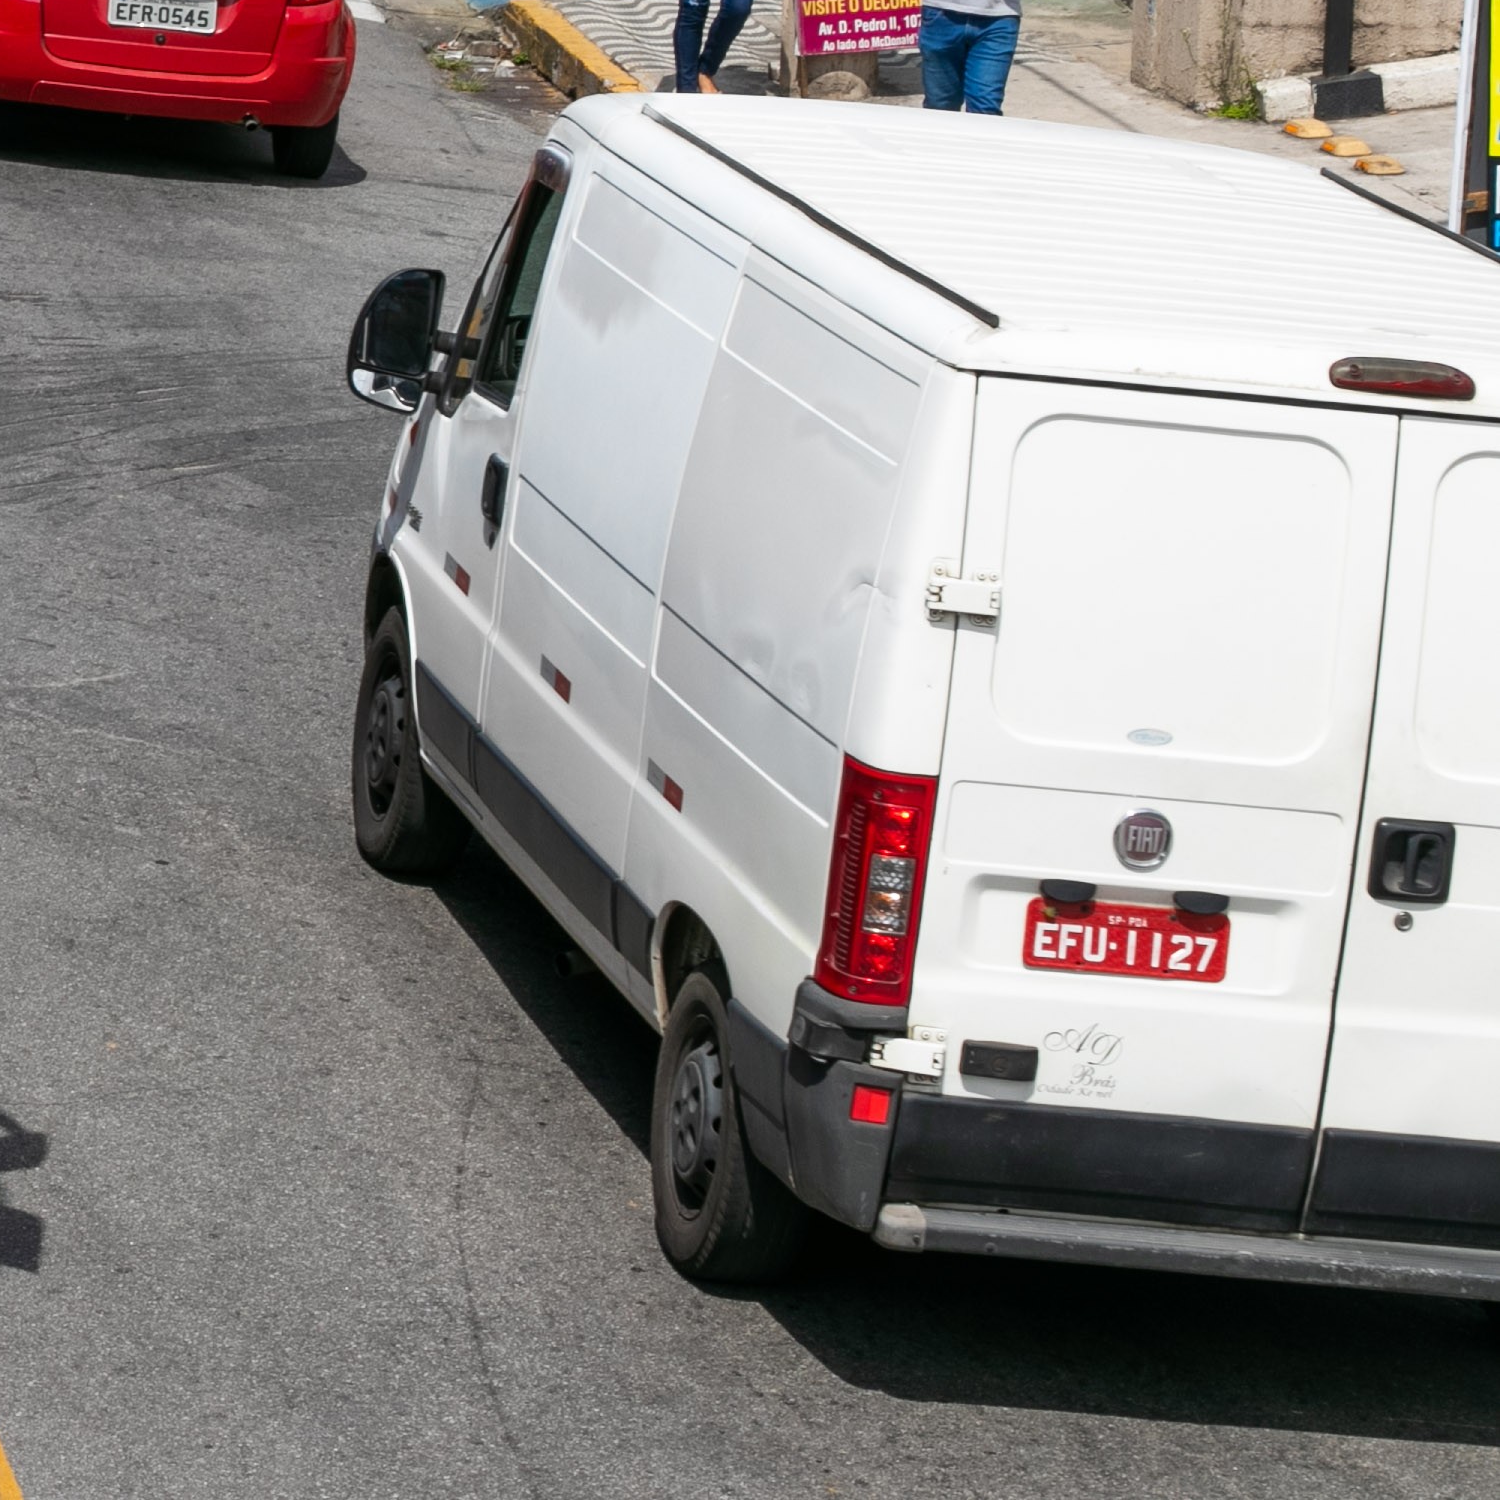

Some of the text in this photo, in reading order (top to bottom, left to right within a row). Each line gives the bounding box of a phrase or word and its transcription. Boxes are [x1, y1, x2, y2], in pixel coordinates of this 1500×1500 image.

[818, 21, 834, 36] Av.
[838, 20, 852, 34] D.
[854, 16, 888, 32] Pedro
[889, 16, 901, 32] II,
[823, 33, 921, 52] Ao lado do McDonald'
[1126, 825, 1164, 854] FIAT
